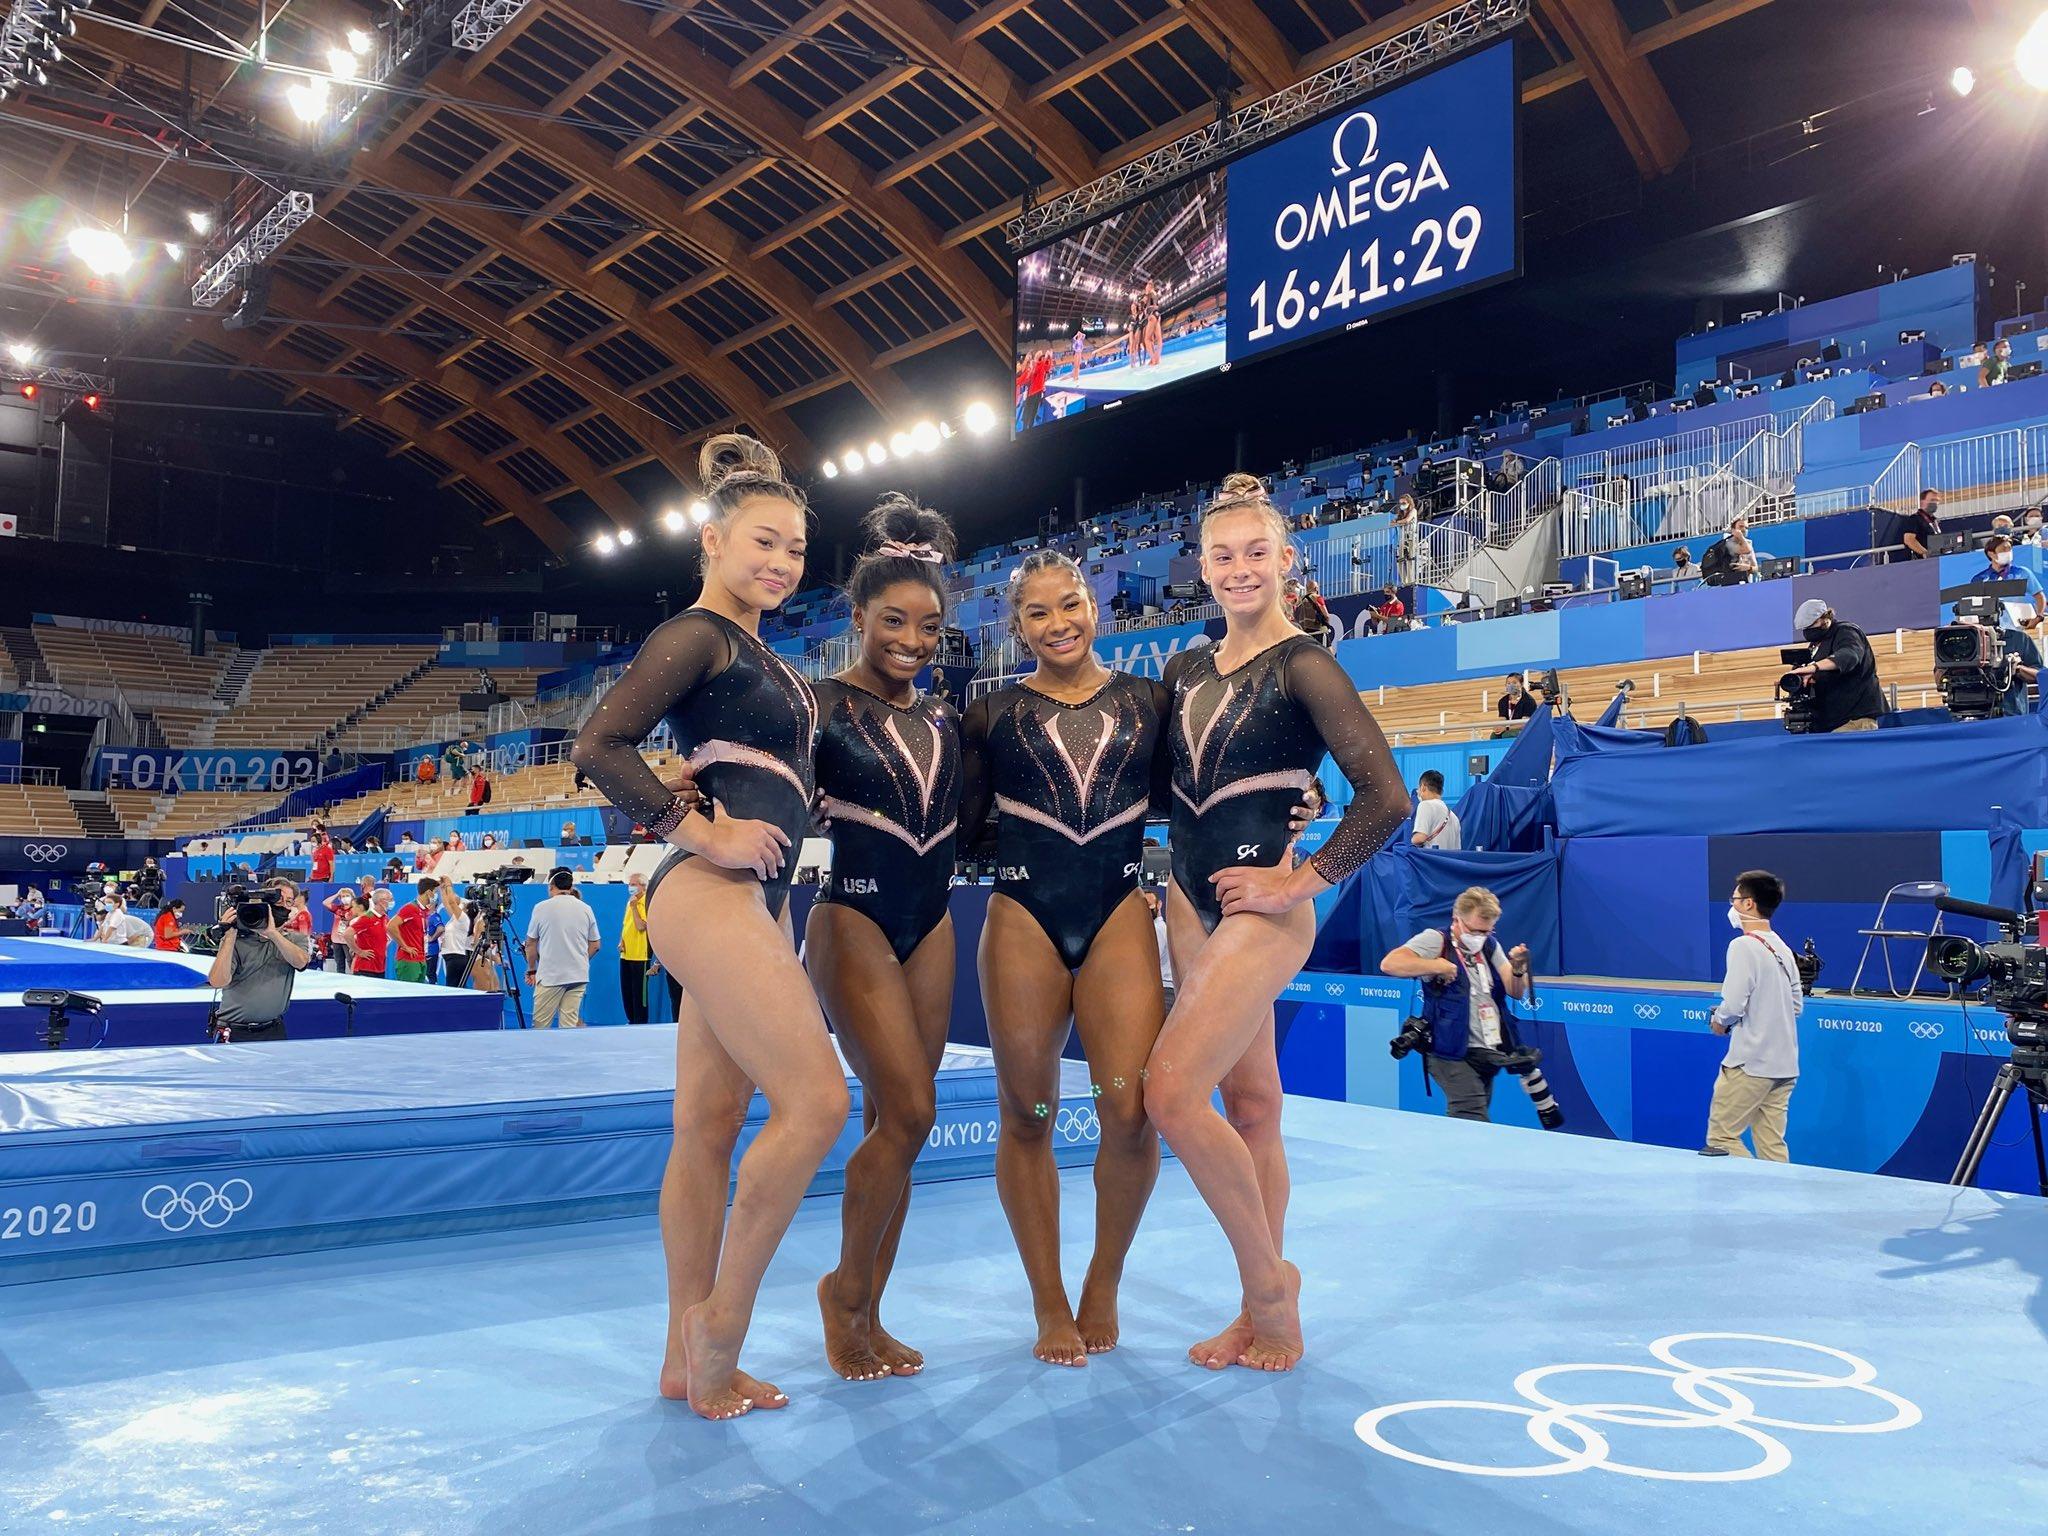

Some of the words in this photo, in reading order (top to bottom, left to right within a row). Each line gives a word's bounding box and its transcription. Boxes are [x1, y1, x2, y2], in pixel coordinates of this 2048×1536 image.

[1275, 145, 1450, 251] OMEGA
[1248, 205, 1482, 341] 16:41:29
[102, 752, 236, 792] TOKYO
[998, 865, 1030, 881] USA
[843, 877, 879, 895] USA
[1360, 987, 1383, 998] TOKYO
[1384, 989, 1401, 999] 2020
[1562, 1001, 1591, 1013] TOKYO
[1592, 1004, 1614, 1014] 2020
[1682, 1009, 1708, 1020] TOKY
[1817, 1018, 1853, 1031] TOKYO
[1855, 1021, 1883, 1033] 2020
[929, 1121, 982, 1148] OKYO
[1, 1201, 97, 1240] 2020
